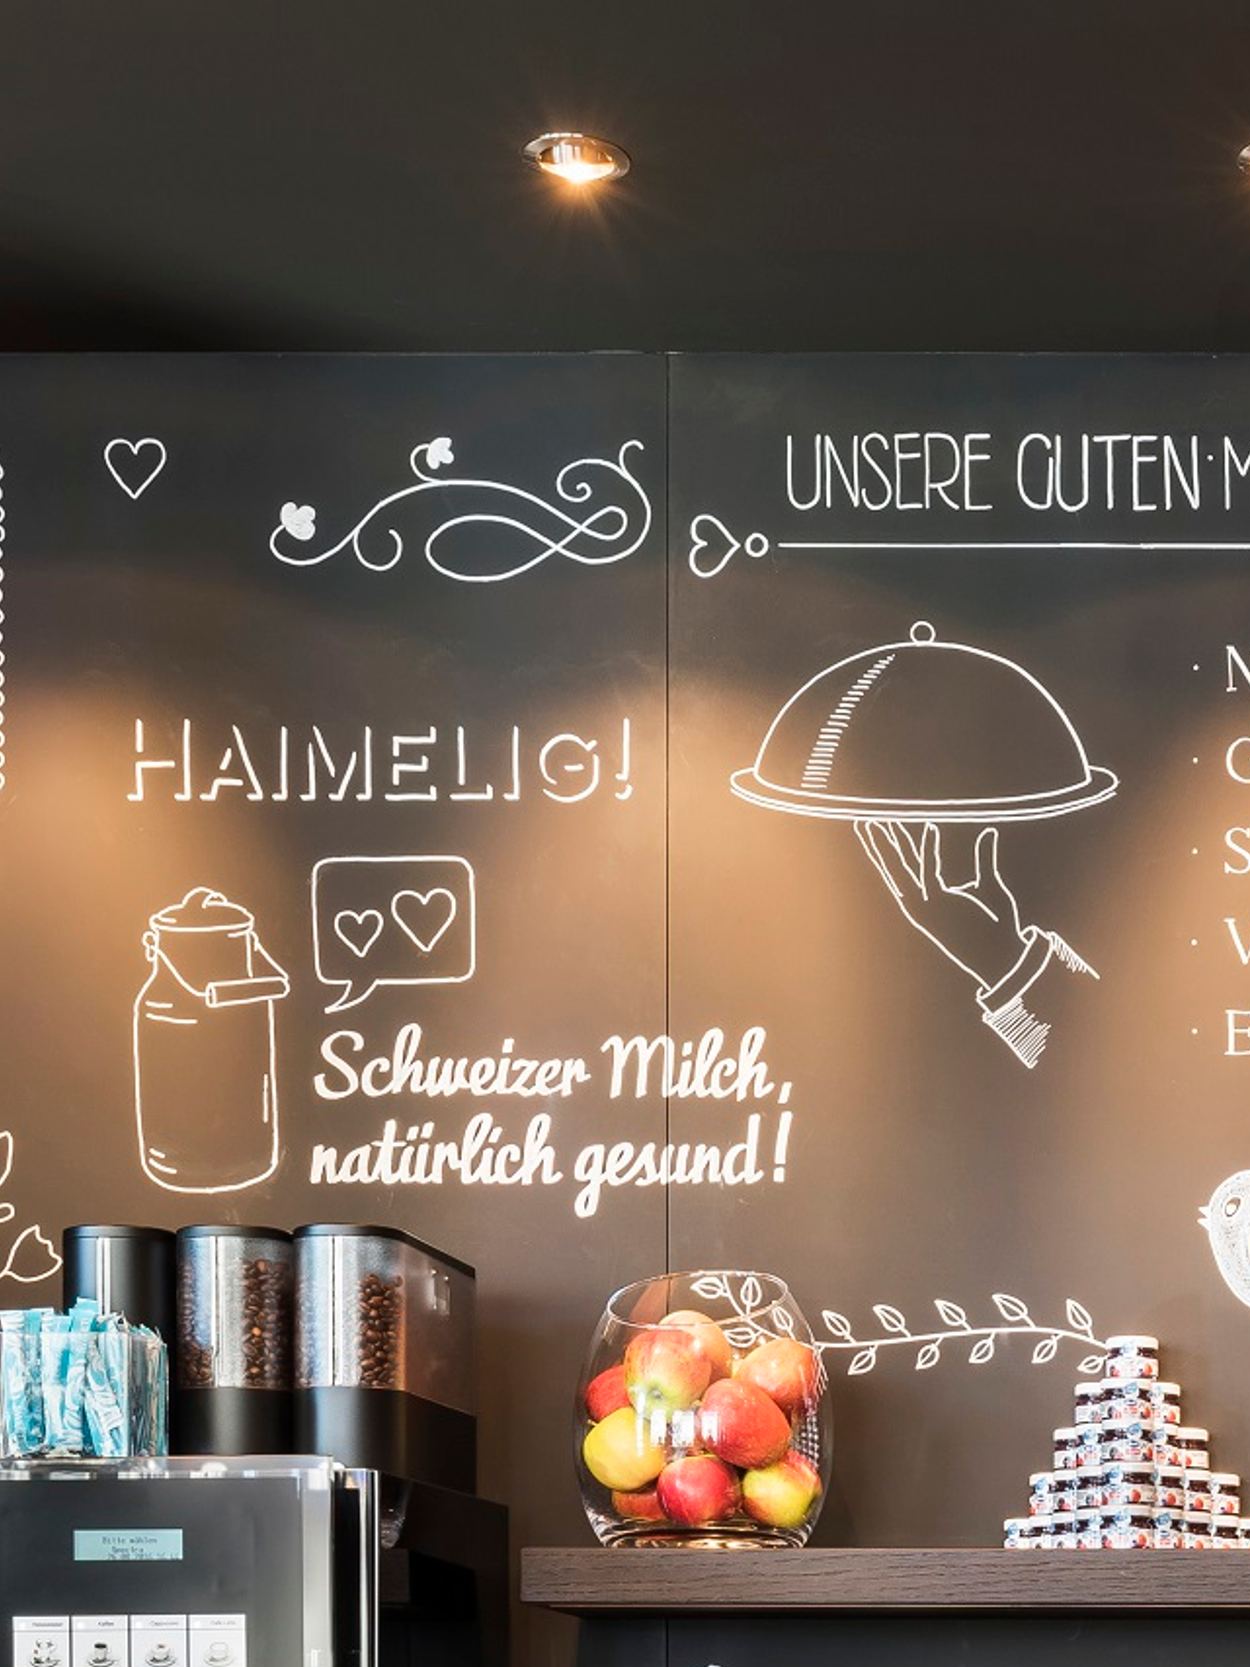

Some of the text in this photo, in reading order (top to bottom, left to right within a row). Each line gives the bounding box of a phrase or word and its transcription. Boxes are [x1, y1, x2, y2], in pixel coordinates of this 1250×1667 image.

[785, 434, 992, 512] UNSERE
[126, 716, 634, 803] HAIMELIG!
[312, 1022, 795, 1105] Schweizer Milch,
[309, 1110, 793, 1219] natürlich gesund!
